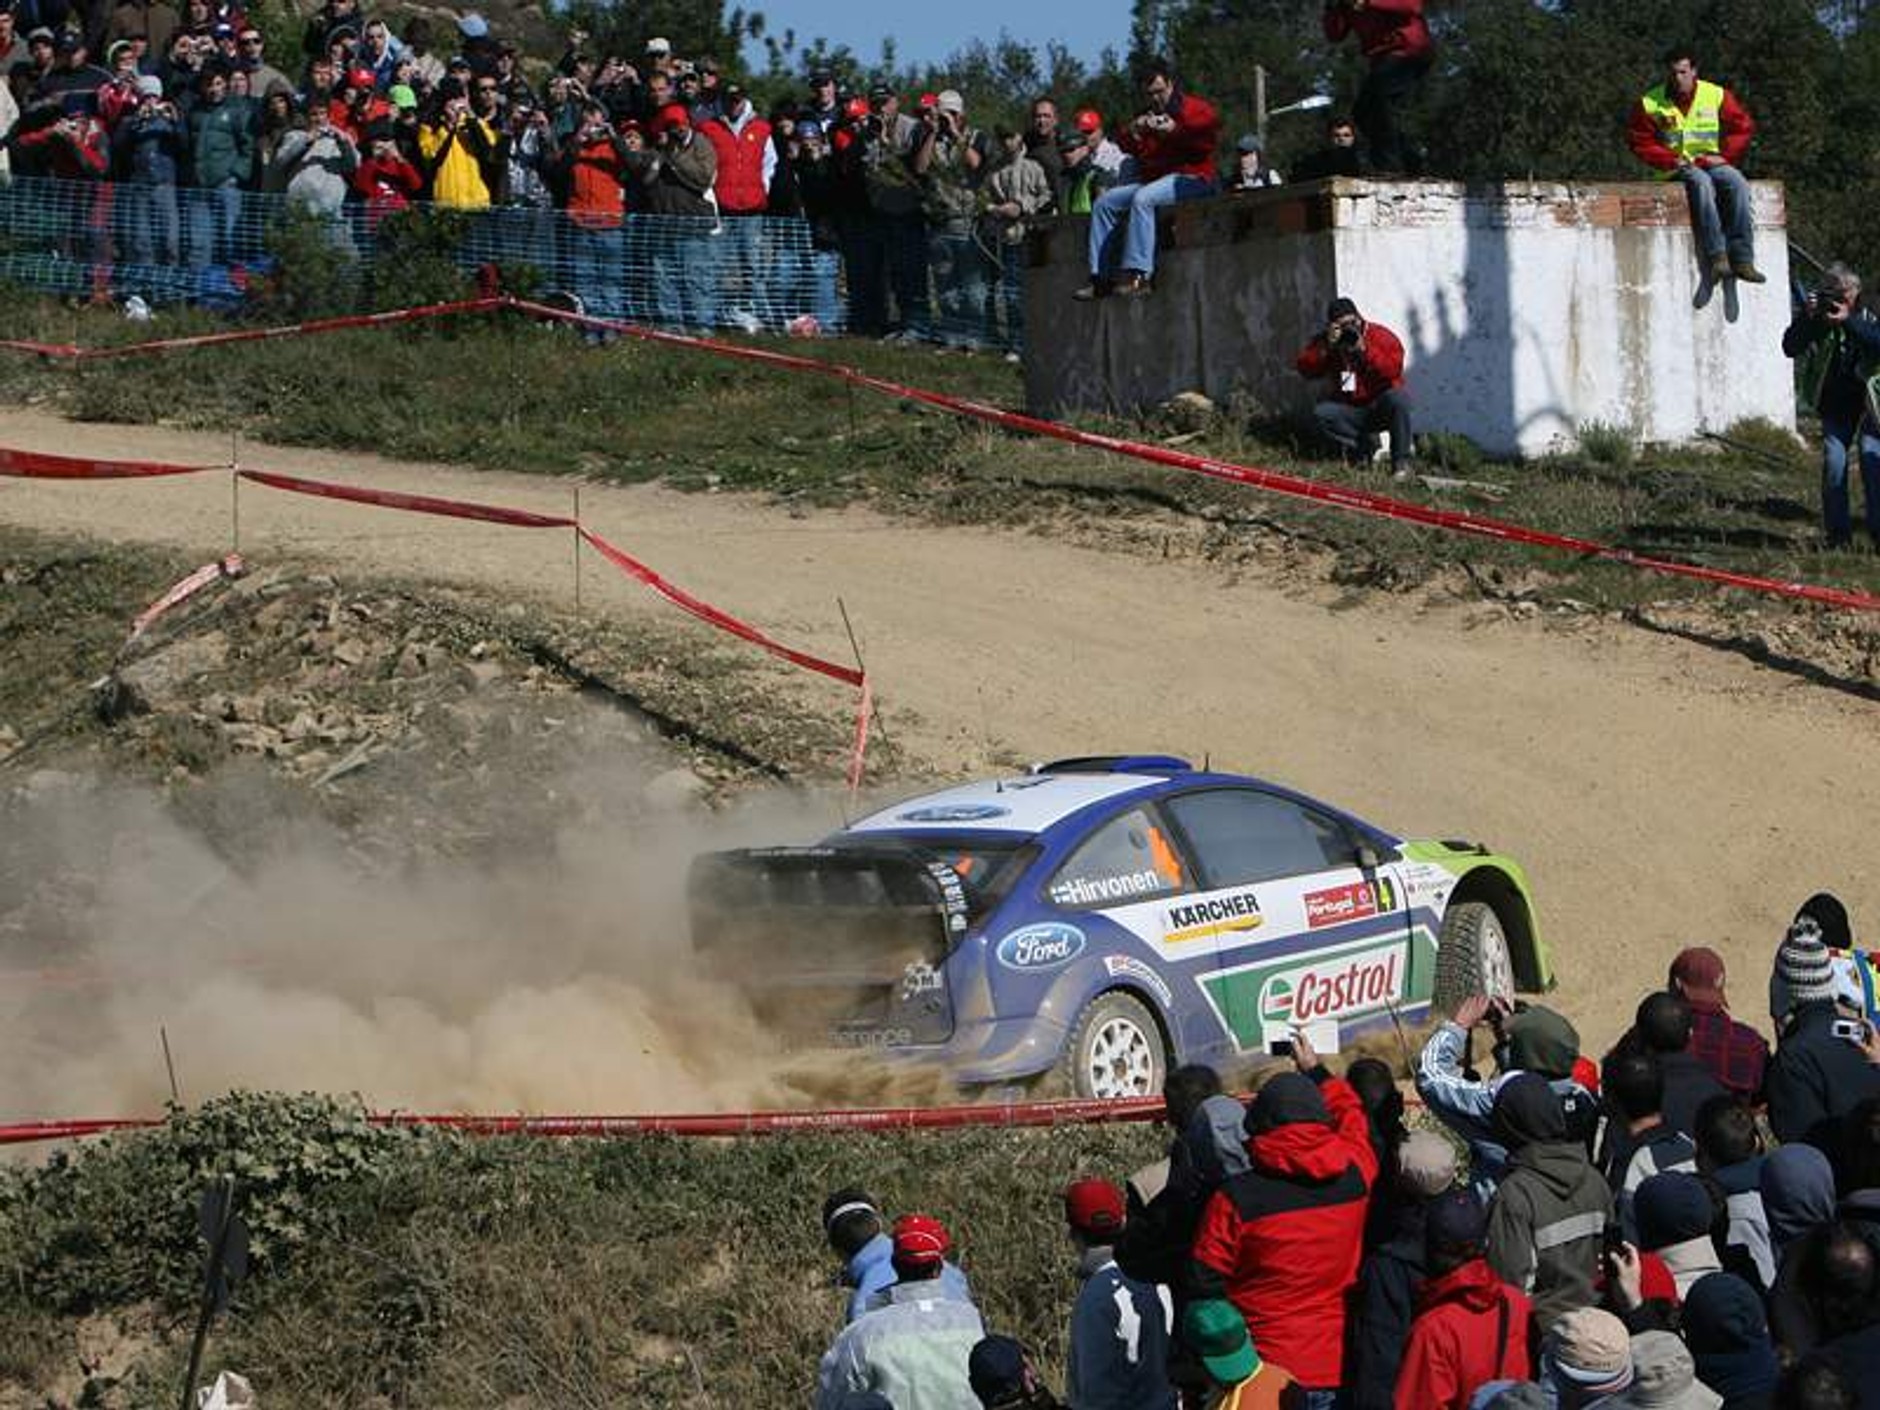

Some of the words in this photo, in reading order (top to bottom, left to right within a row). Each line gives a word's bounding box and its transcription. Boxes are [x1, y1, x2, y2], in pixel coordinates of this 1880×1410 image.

[1066, 871, 1159, 903] Hirvonen
[1016, 932, 1070, 965] Ford
[1295, 954, 1395, 1020] Castrol
